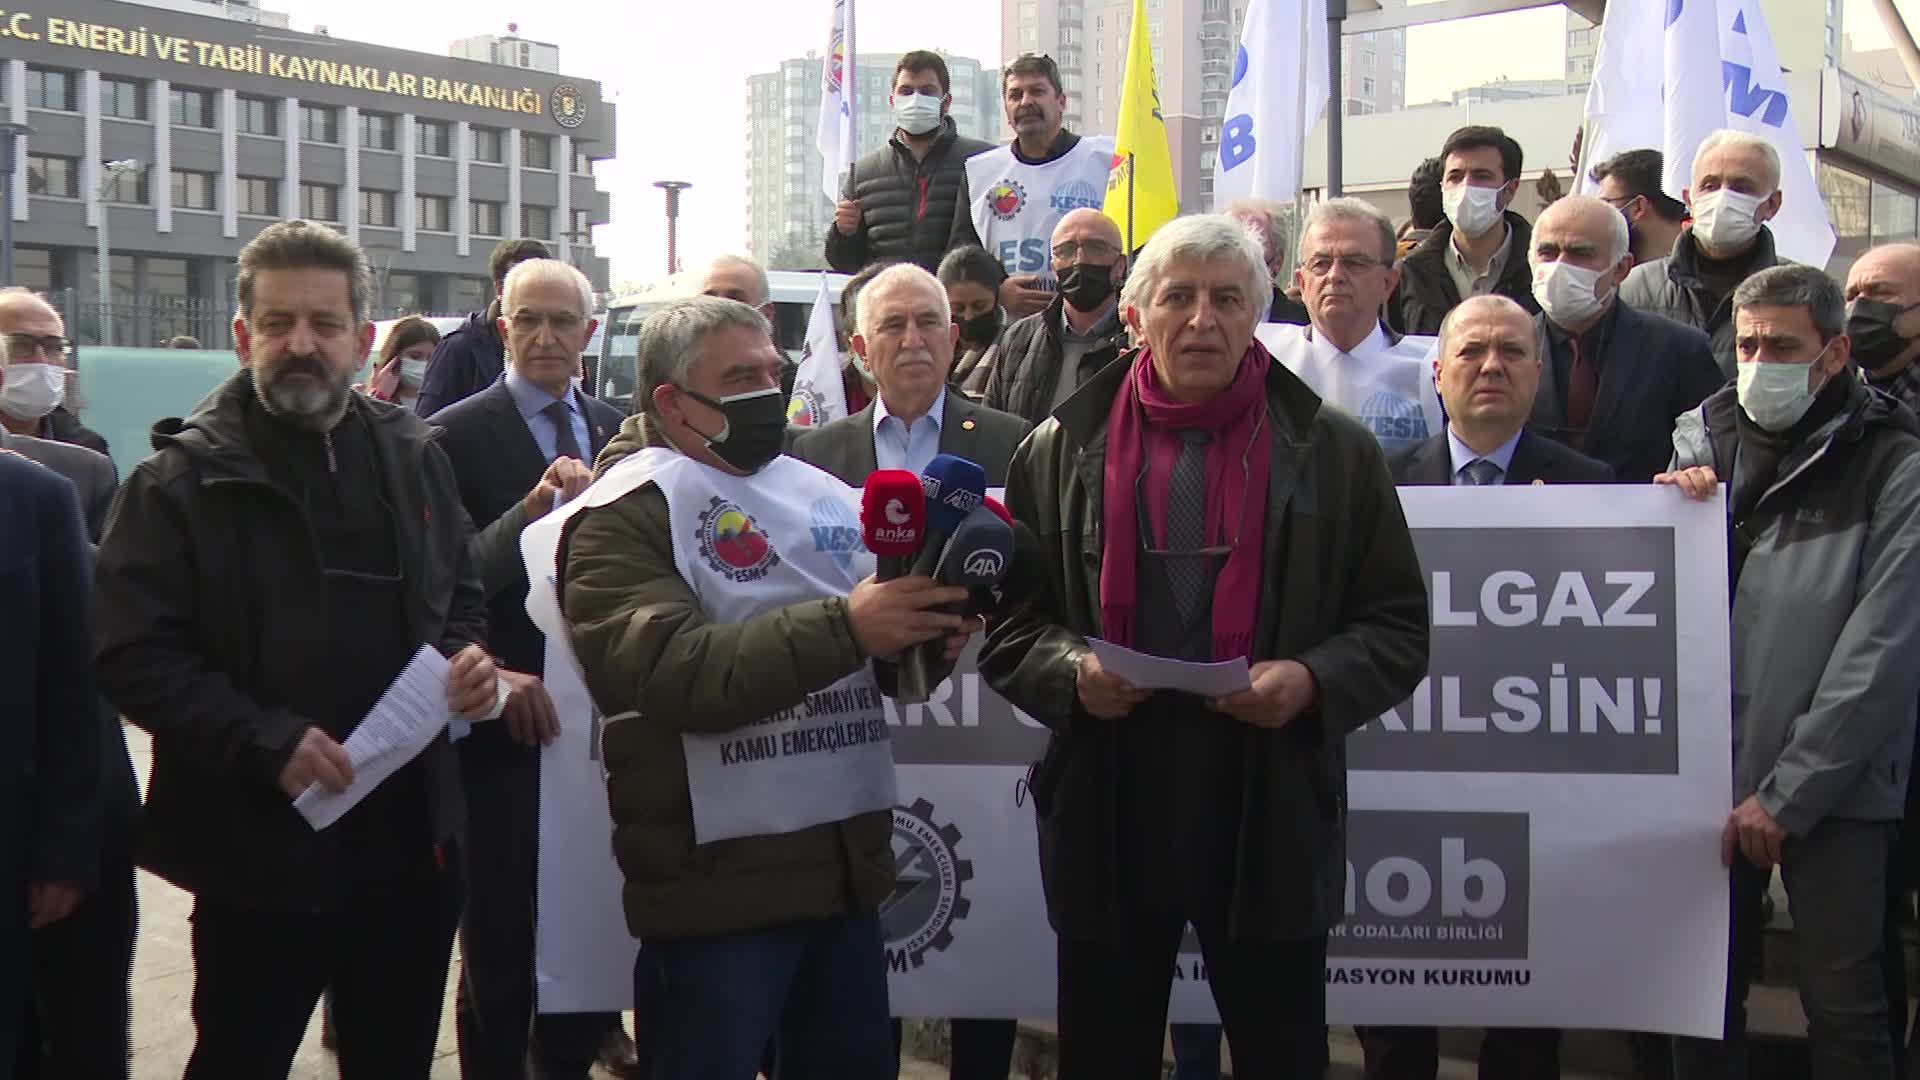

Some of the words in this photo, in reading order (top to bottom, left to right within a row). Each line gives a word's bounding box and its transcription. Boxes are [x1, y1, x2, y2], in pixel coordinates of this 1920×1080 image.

[47, 17, 149, 58] ENERJİ
[151, 34, 191, 63] VE
[192, 41, 263, 74] TABİİ
[268, 52, 418, 97] KAYNAKLAR
[421, 76, 543, 115] BAKANLIĞI
[1000, 238, 1054, 273] ES
[1356, 662, 1662, 735] ILSİN!
[720, 735, 777, 766] KAMU
[782, 717, 866, 756] EMEKÇİLERİ
[1344, 837, 1507, 919] ob
[1352, 924, 1431, 940] ODALARI
[1423, 969, 1531, 986] KURUMU
